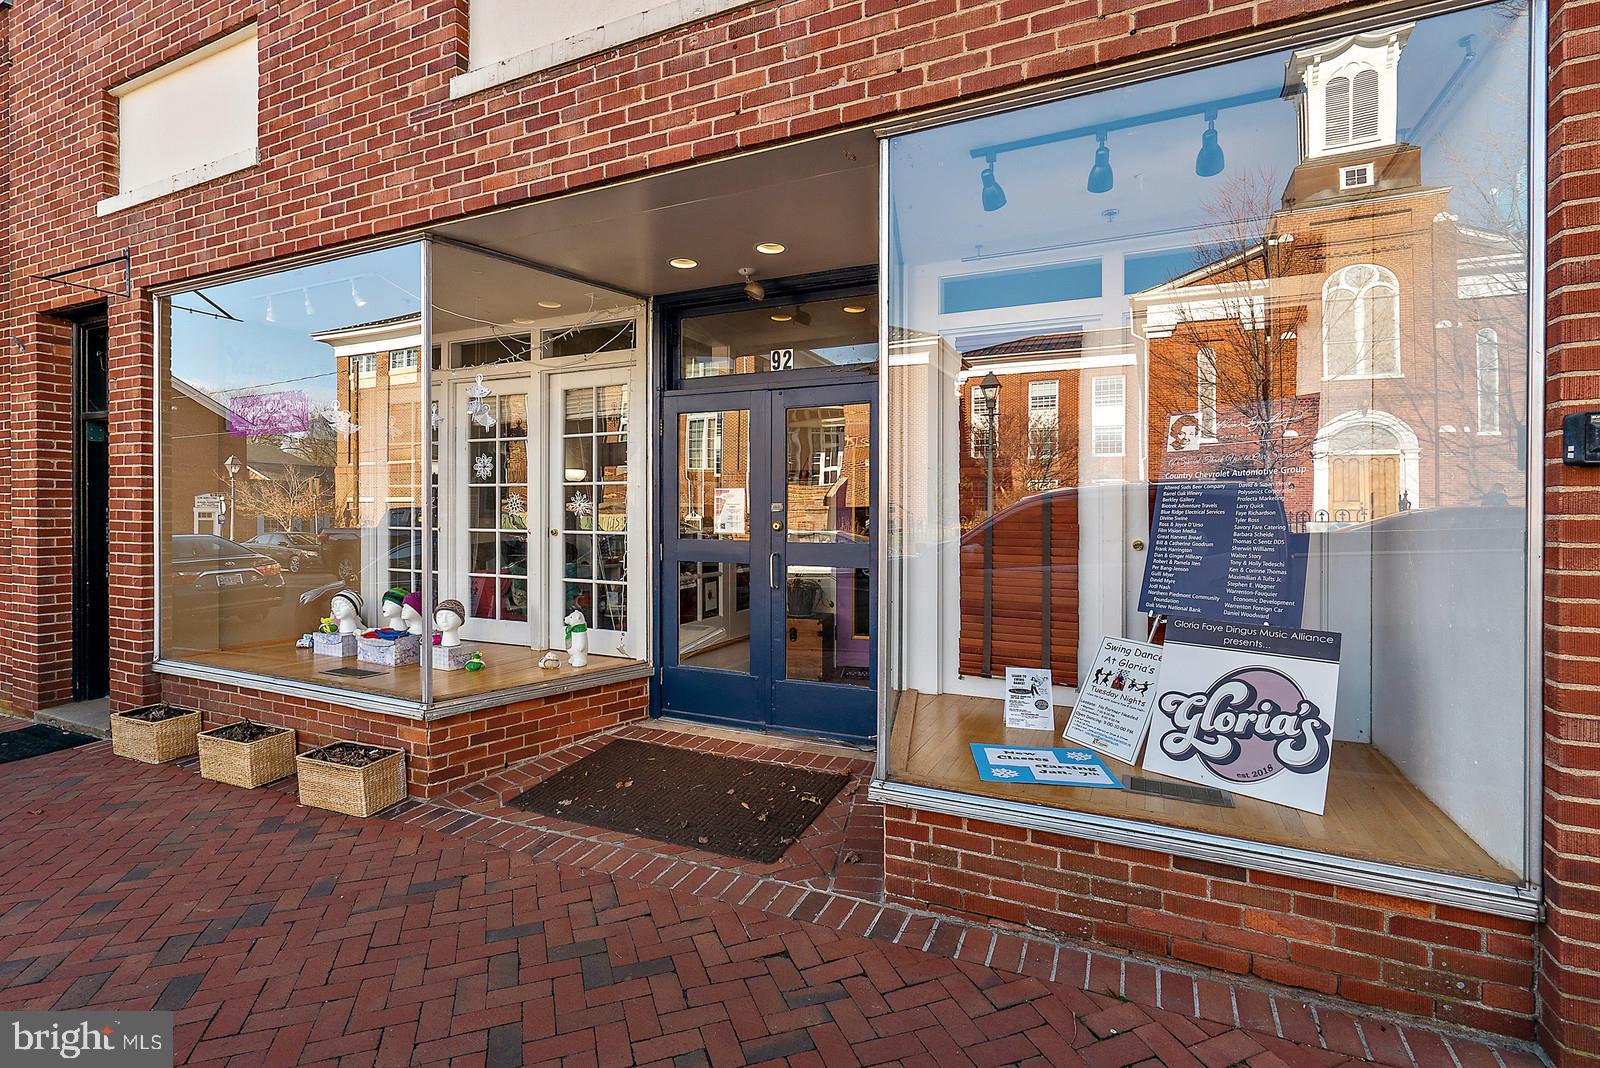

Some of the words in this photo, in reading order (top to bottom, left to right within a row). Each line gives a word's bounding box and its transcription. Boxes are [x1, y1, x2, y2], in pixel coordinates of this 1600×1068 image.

[771, 350, 792, 370] 92
[1165, 471, 1192, 481] Country
[1196, 470, 1230, 478] Chevrolet
[1232, 466, 1278, 477] Automotive
[1281, 466, 1306, 474] Group
[1192, 594, 1220, 602] Community
[1259, 598, 1295, 606] Development
[1240, 611, 1270, 619] Woodward
[1174, 620, 1200, 629] Gloria
[1201, 623, 1223, 632] Faye
[1226, 625, 1257, 637] Dingus
[1259, 630, 1288, 639] Music
[1291, 632, 1334, 644] Alliance
[1105, 642, 1132, 656] Swing
[1223, 636, 1271, 649] presents...
[1104, 656, 1117, 665] At
[1118, 659, 1156, 675] Gloria's
[1091, 685, 1119, 700] Tuesday
[1120, 694, 1146, 707] Nights
[1158, 680, 1331, 774] Gloria's
[1034, 764, 1097, 772] starting
[1236, 771, 1250, 779] est
[1251, 764, 1273, 778] 2018
